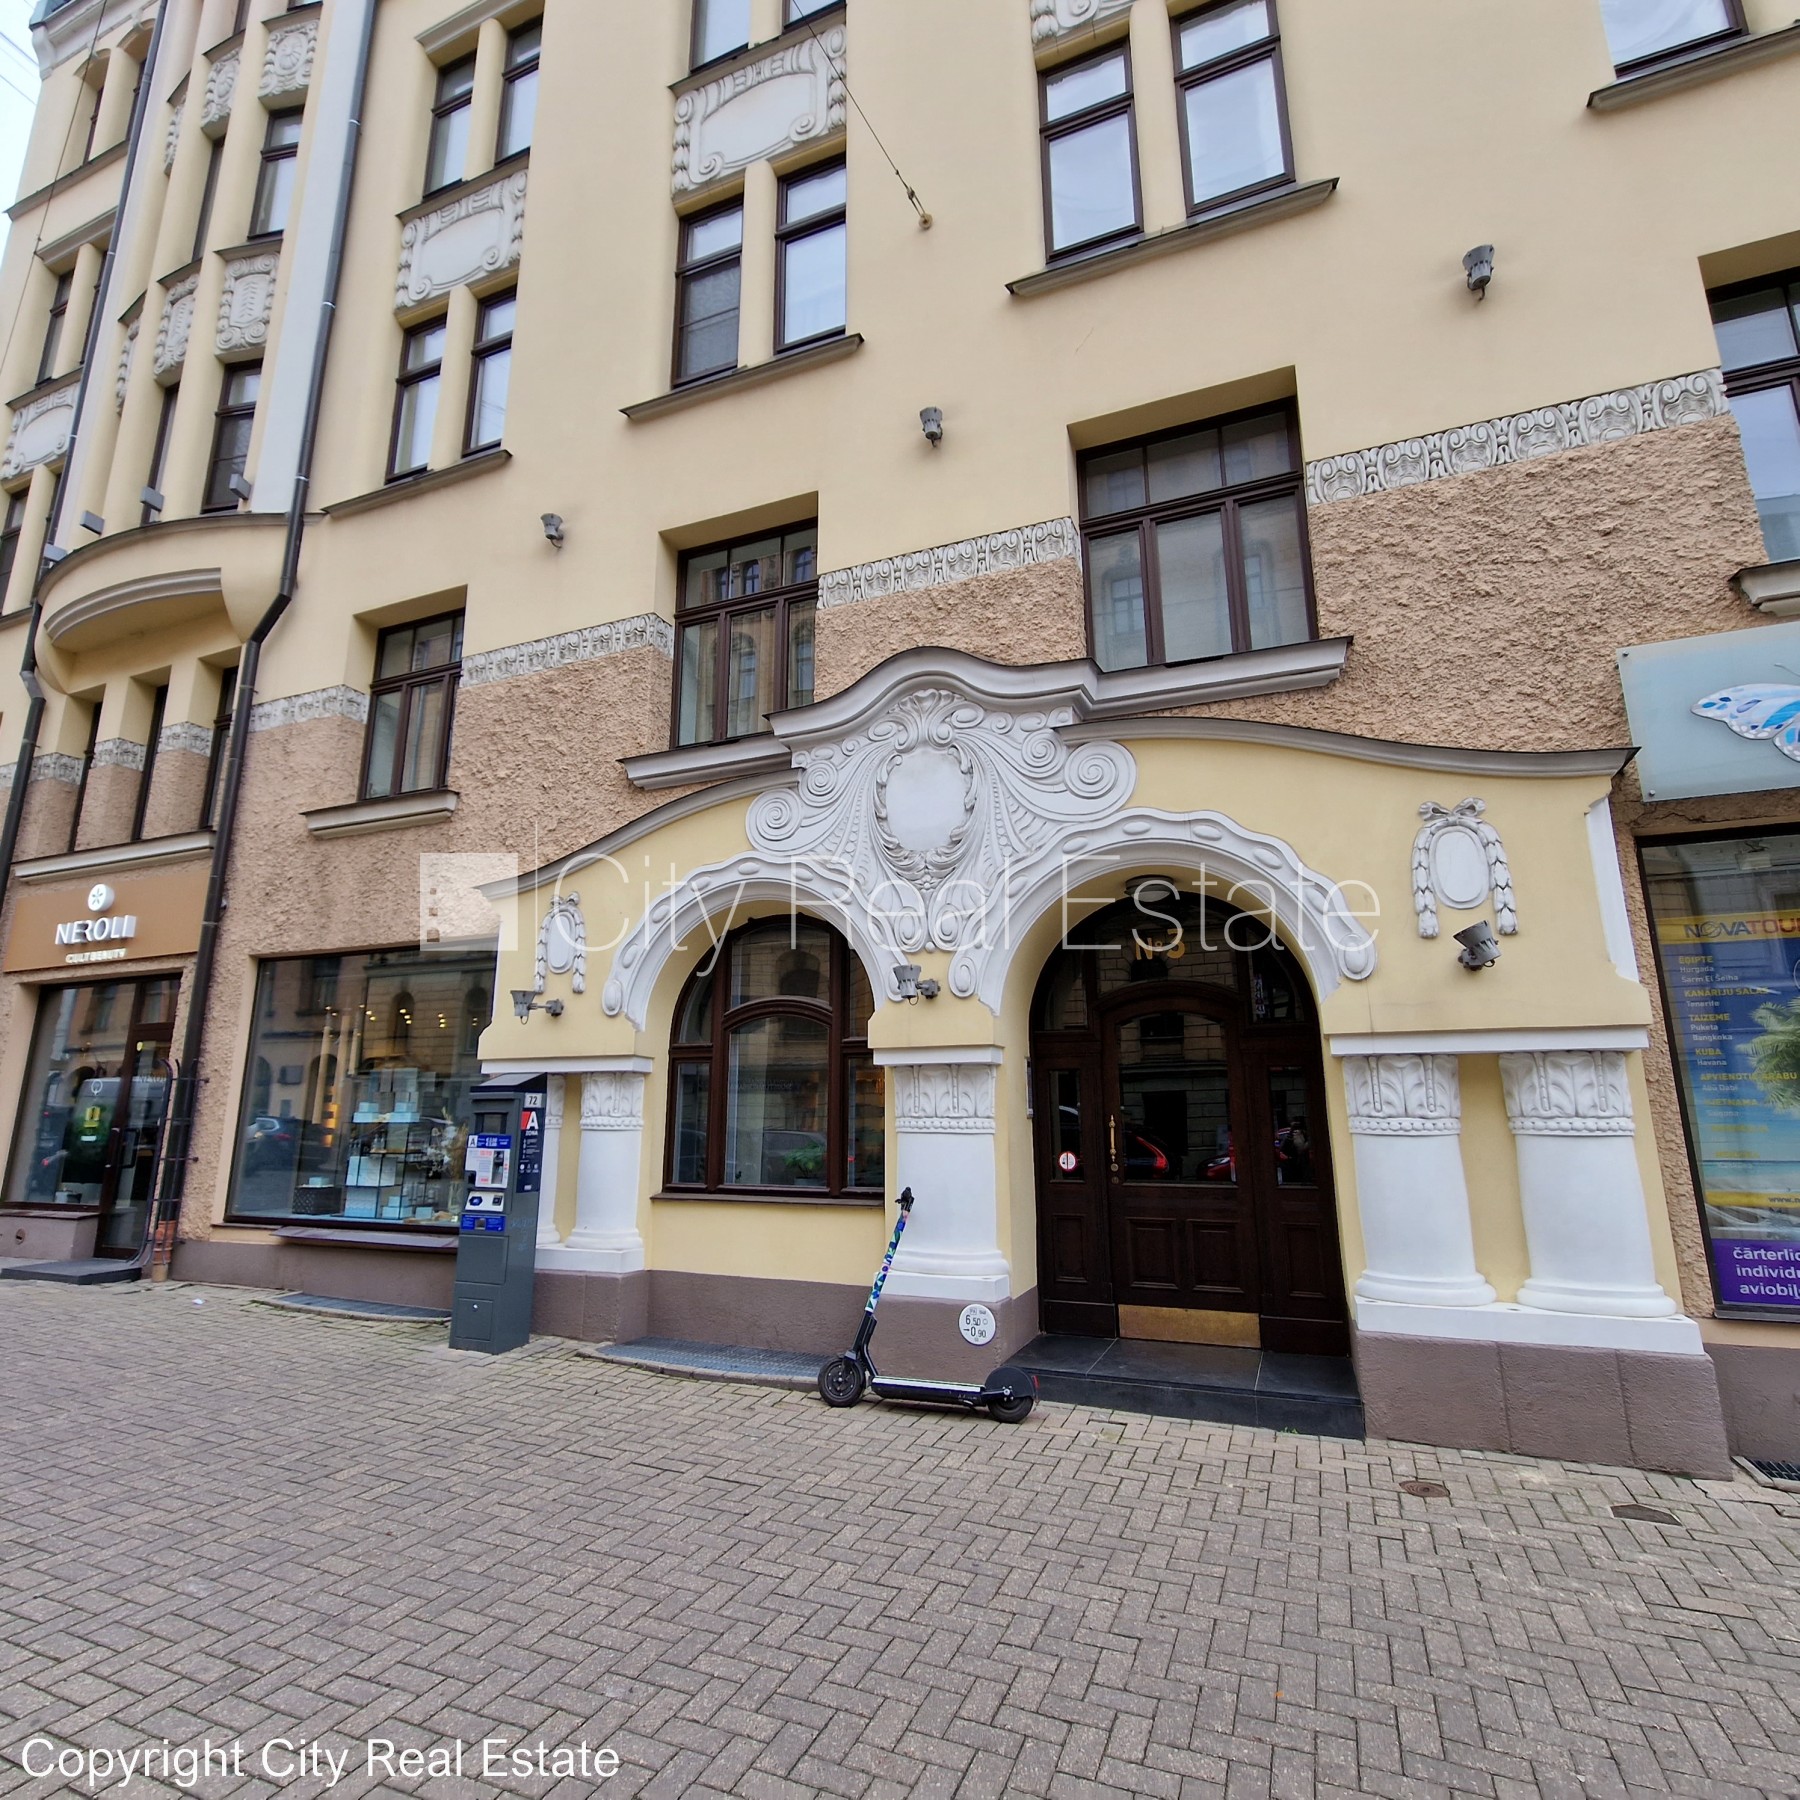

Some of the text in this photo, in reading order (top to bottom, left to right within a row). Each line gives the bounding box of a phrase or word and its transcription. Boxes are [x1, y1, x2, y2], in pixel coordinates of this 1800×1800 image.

[54, 915, 137, 945] NEROLI
[1685, 918, 1800, 938] NOVATOU
[1167, 928, 1185, 959] 3
[1695, 1048, 1722, 1056] KUBA
[529, 1095, 538, 1105] 72
[527, 1111, 539, 1130] A
[469, 1138, 476, 1147] A
